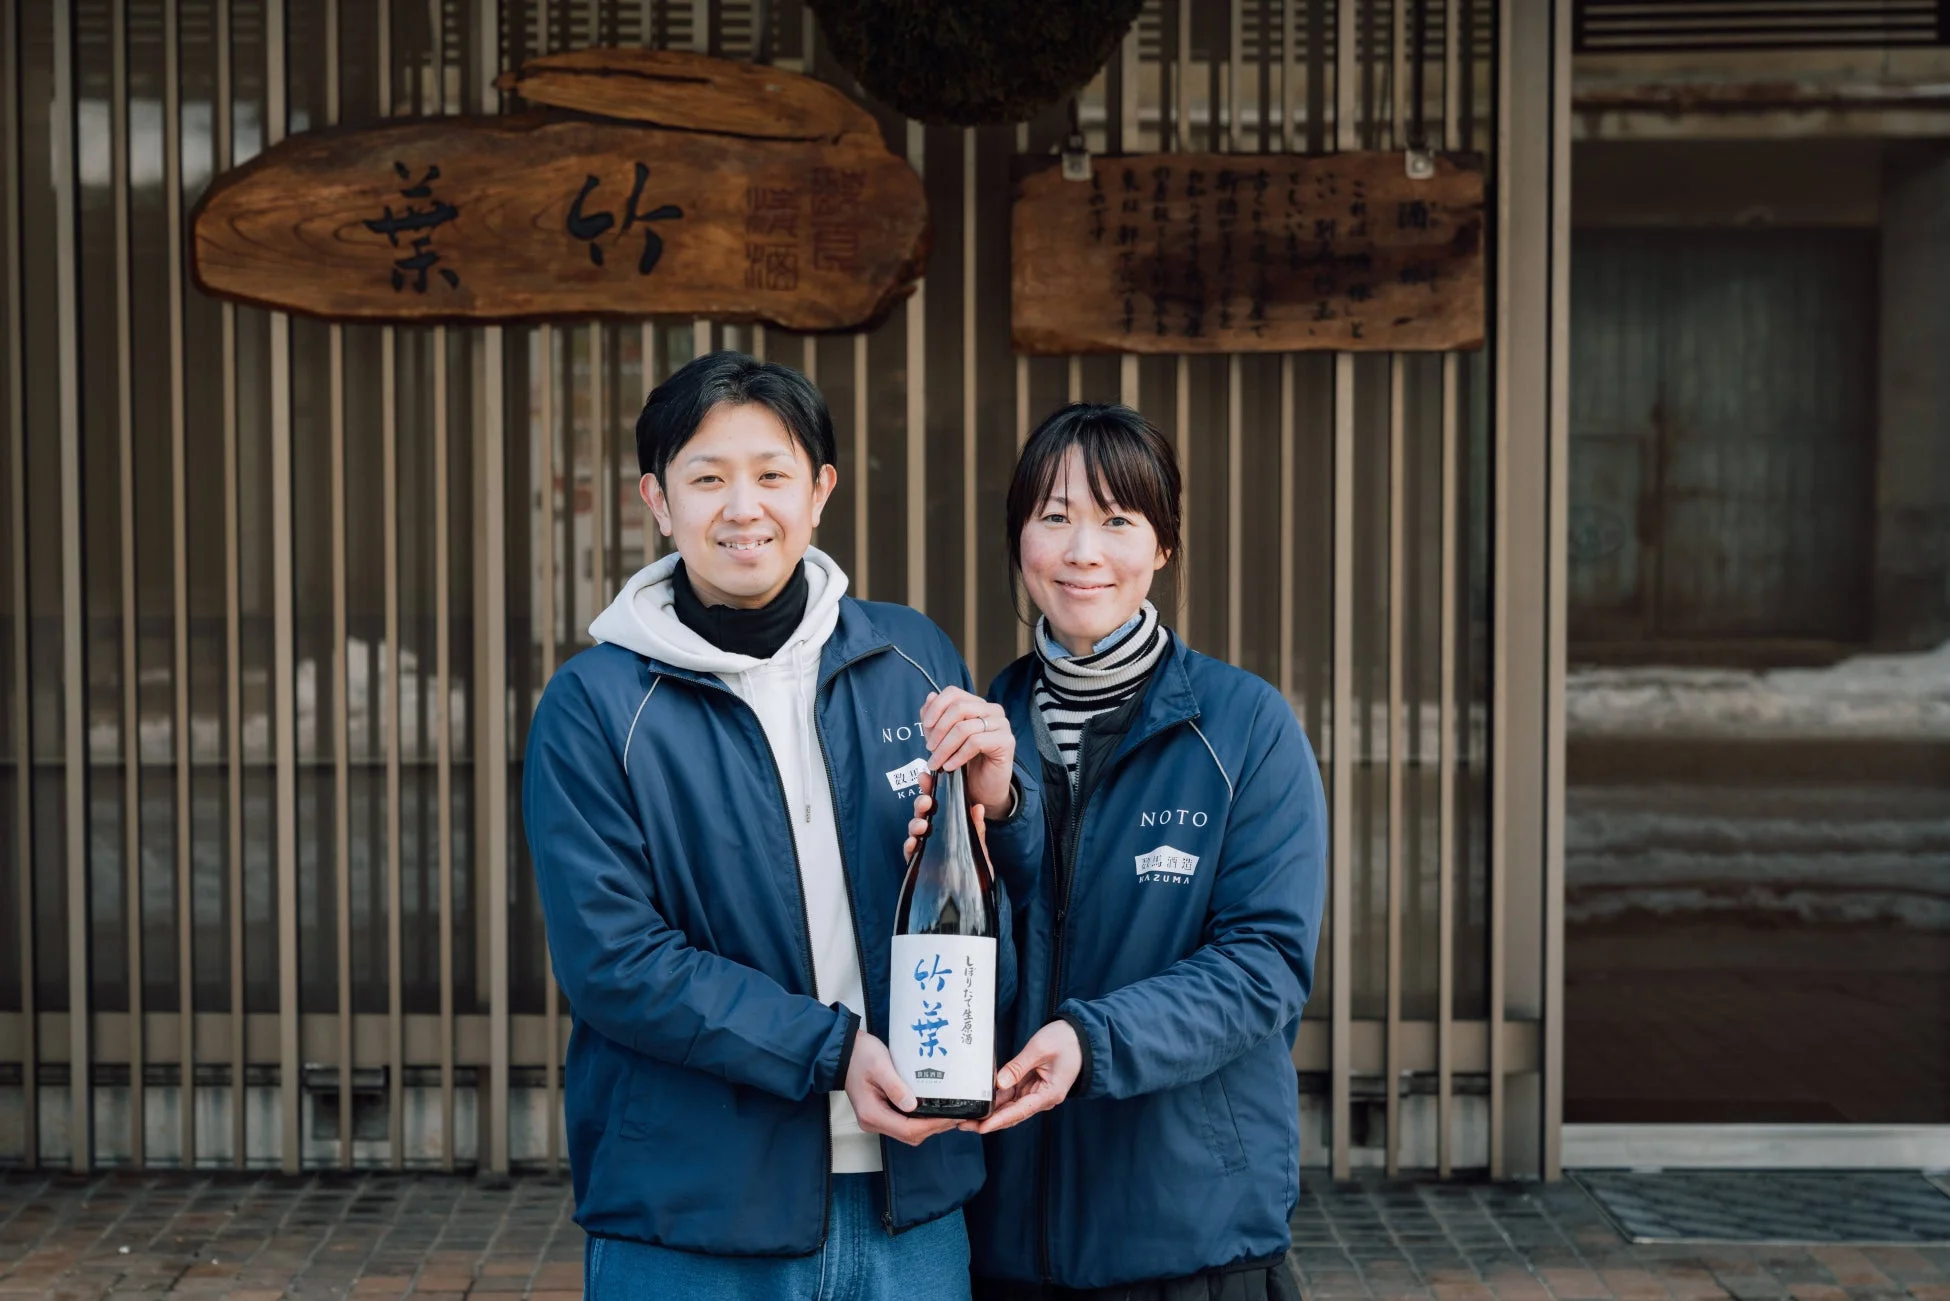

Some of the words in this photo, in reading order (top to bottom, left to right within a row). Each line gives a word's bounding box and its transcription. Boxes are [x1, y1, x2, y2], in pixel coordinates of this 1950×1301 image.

[882, 722, 925, 743] NOT
[898, 787, 925, 799] KAZ
[1140, 809, 1208, 827] NOTO
[1139, 874, 1190, 884] KAZUMA
[911, 954, 953, 1058] 竹葉
[961, 955, 977, 1045] しぼりたて生原酒
